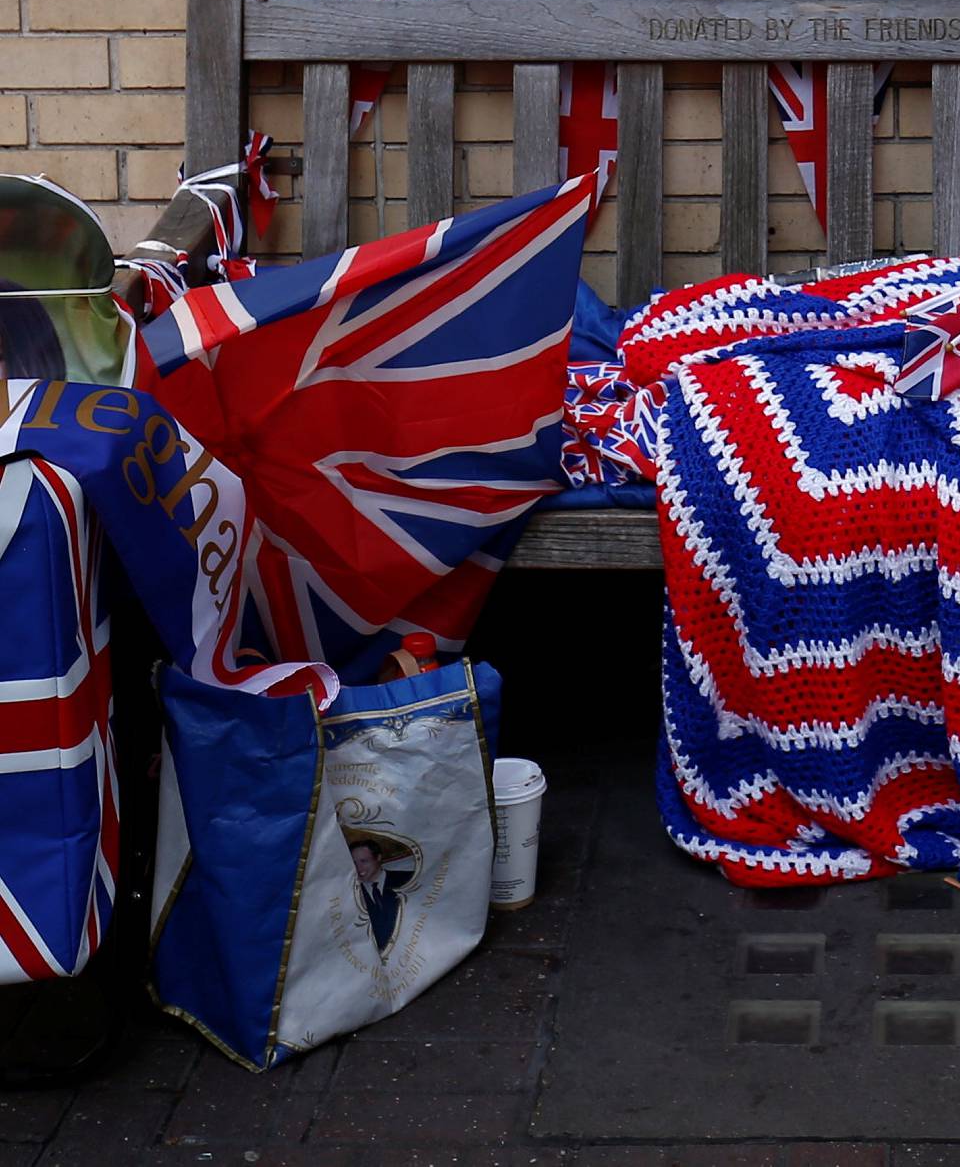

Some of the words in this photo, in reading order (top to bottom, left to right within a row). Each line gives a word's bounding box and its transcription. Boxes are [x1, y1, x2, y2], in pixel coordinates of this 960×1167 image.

[650, 17, 751, 41] DONATED
[765, 17, 795, 41] BY
[808, 17, 852, 41] THE
[328, 774, 377, 793] edding
